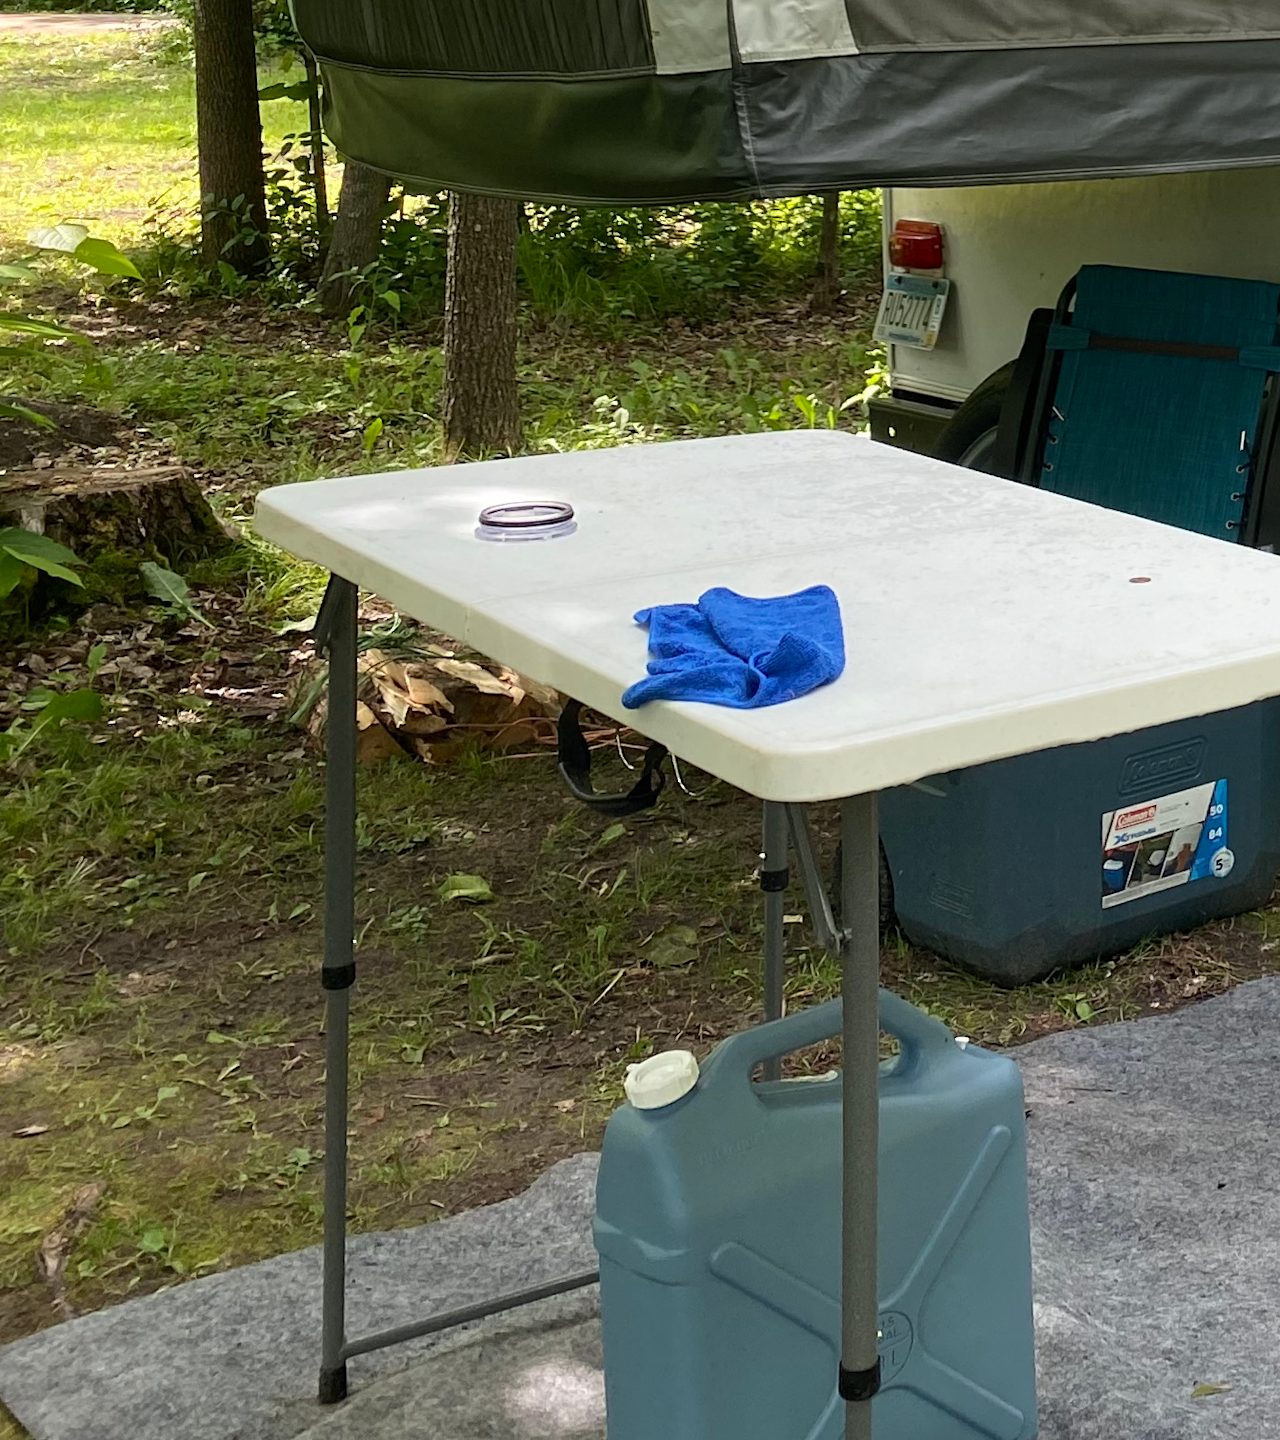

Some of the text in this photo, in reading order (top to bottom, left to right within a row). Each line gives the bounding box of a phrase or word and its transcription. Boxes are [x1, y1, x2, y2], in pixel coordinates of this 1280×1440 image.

[1210, 804, 1224, 817] 50
[1208, 827, 1223, 840] 84
[1215, 859, 1223, 871] 5
